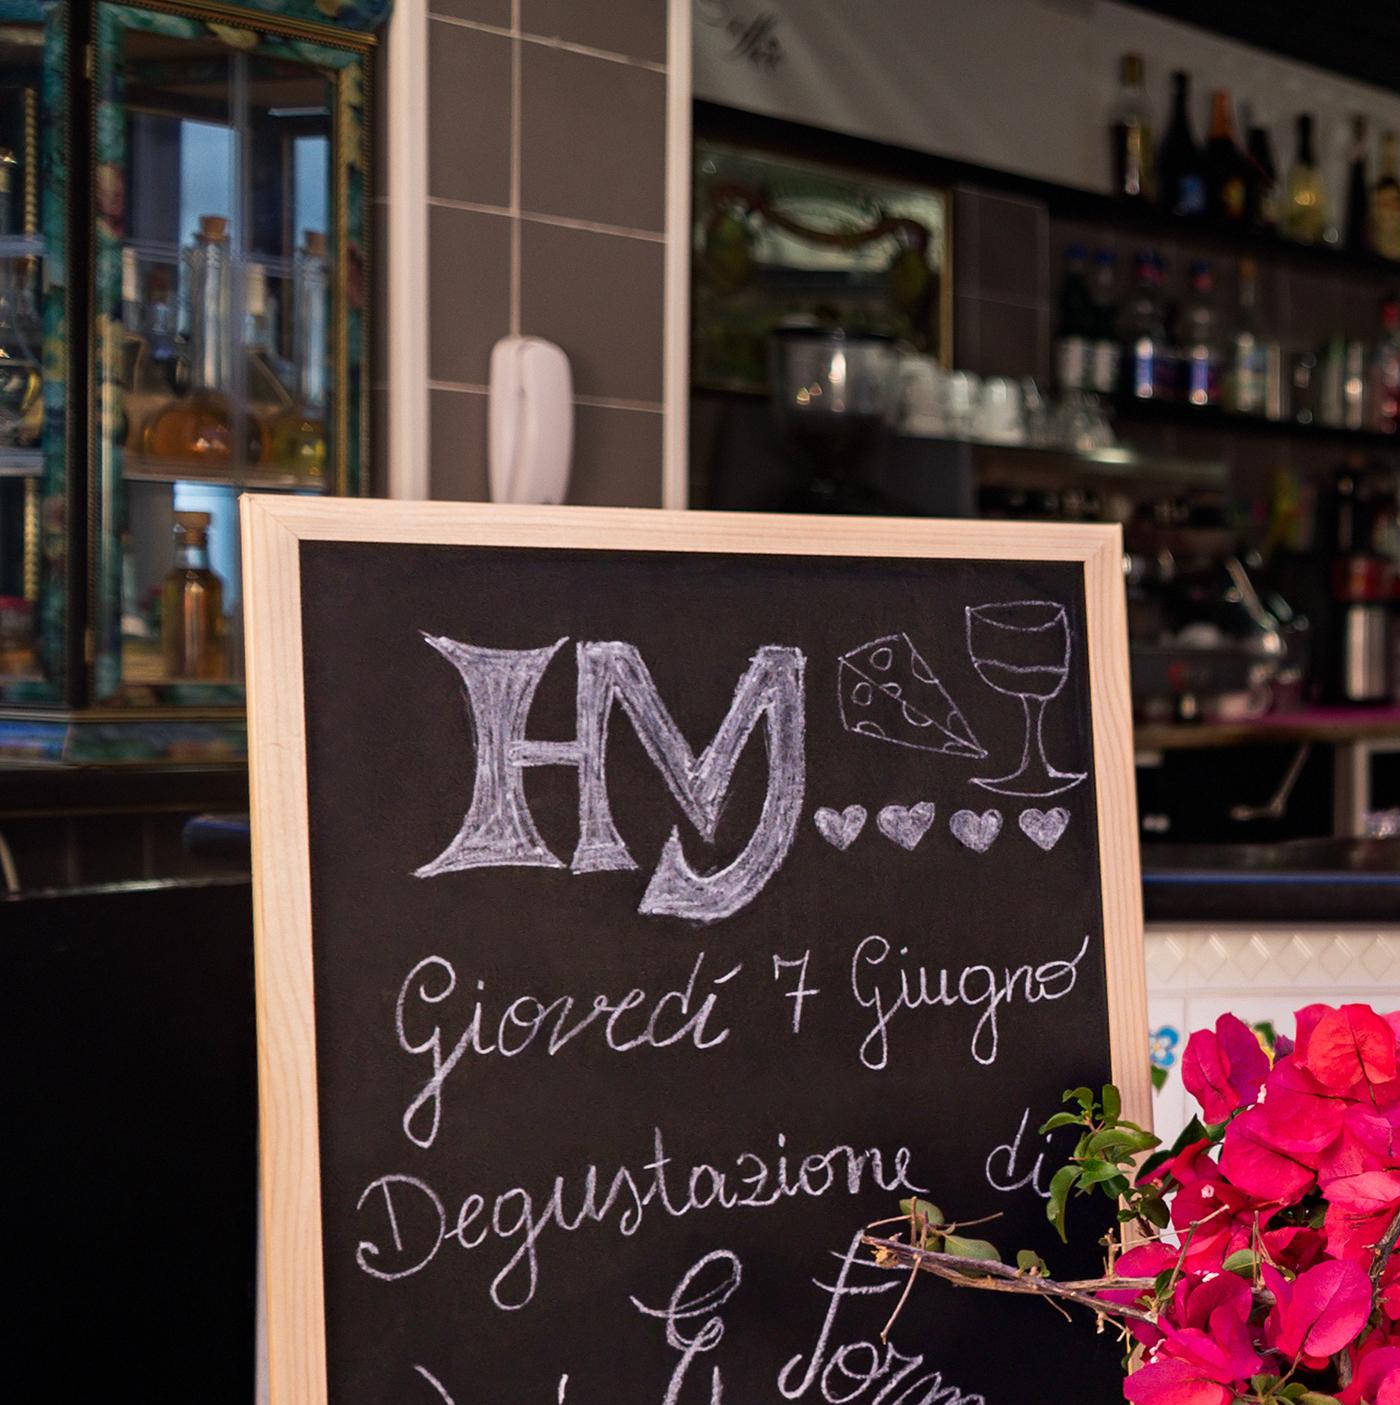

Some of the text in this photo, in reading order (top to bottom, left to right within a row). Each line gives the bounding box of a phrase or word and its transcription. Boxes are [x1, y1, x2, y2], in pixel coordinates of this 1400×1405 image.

[773, 950, 819, 1033] 7
[852, 935, 1090, 1070] Giugno
[356, 1108, 1053, 1310] Degustazione di
